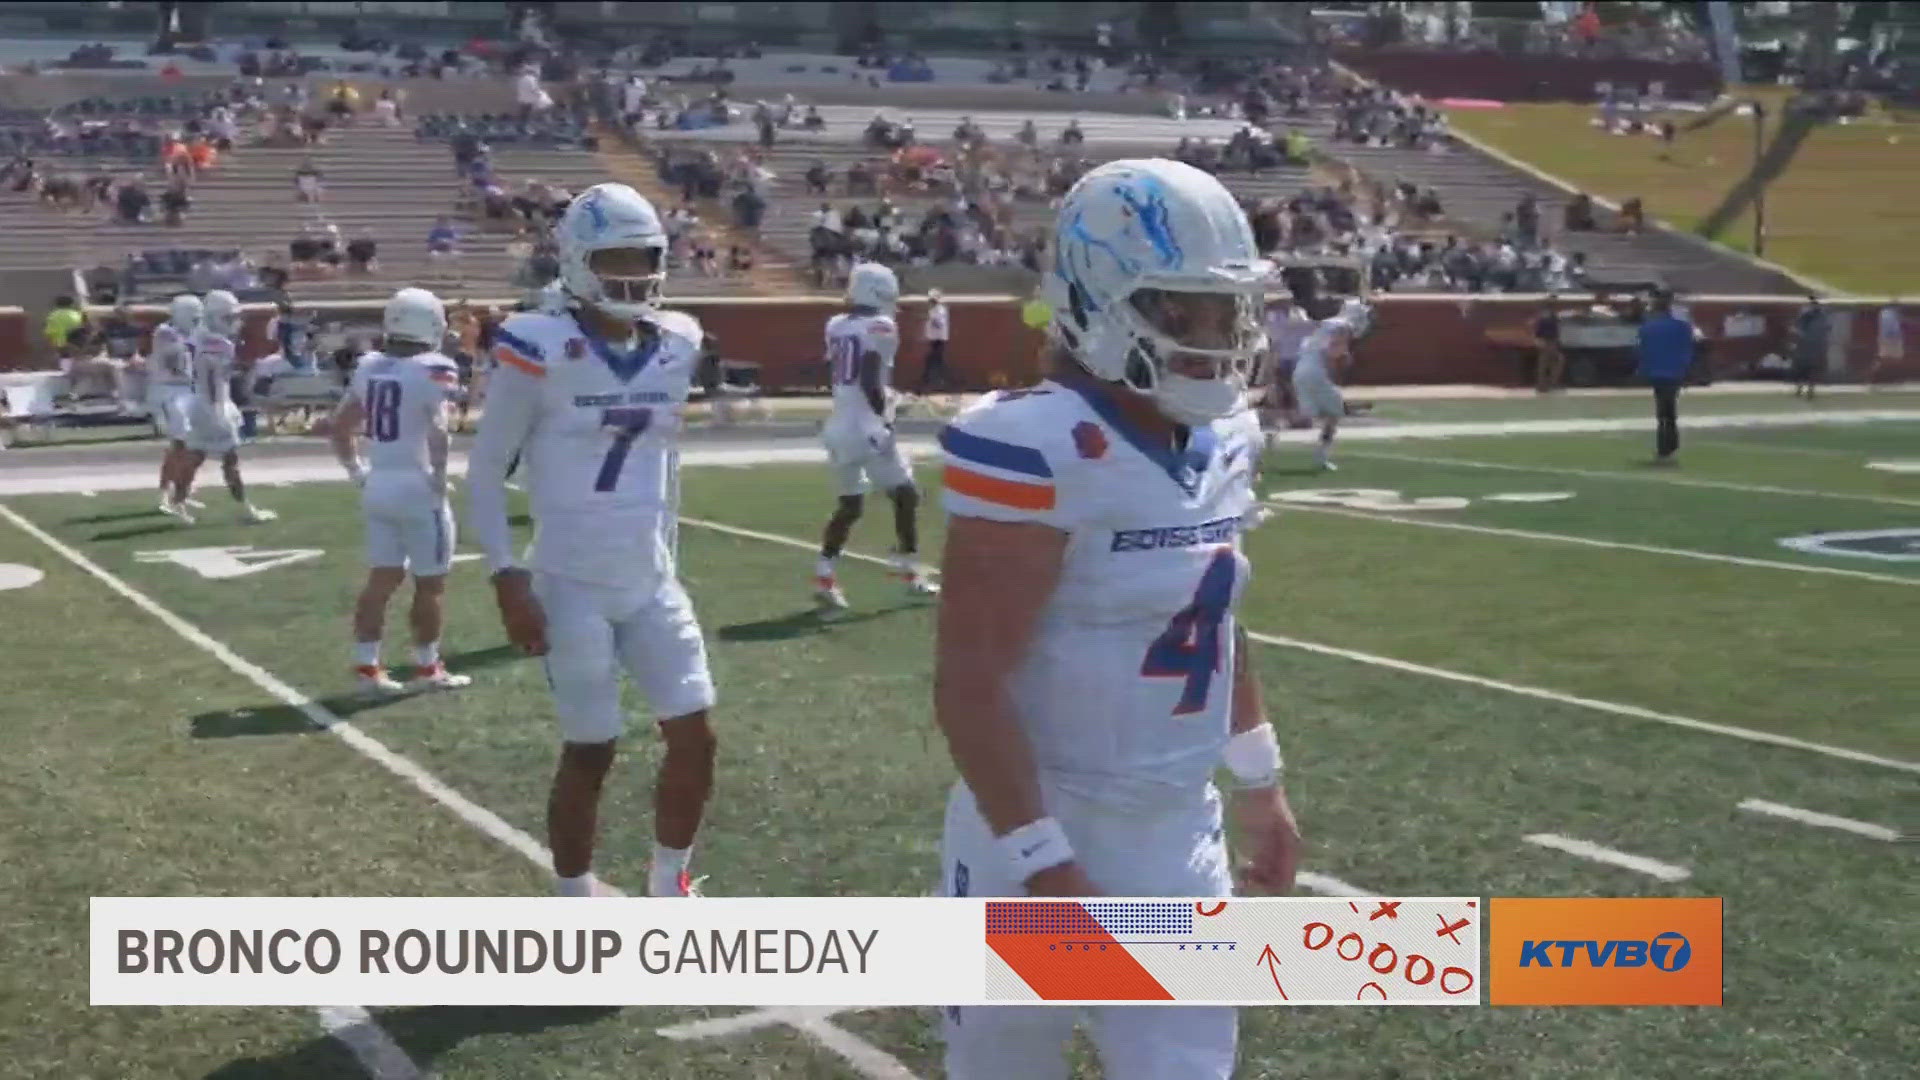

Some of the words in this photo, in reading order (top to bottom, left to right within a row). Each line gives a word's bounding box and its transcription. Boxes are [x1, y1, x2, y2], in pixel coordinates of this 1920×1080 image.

[367, 379, 401, 442] 18
[594, 408, 652, 492] 7
[1140, 547, 1236, 715] 4
